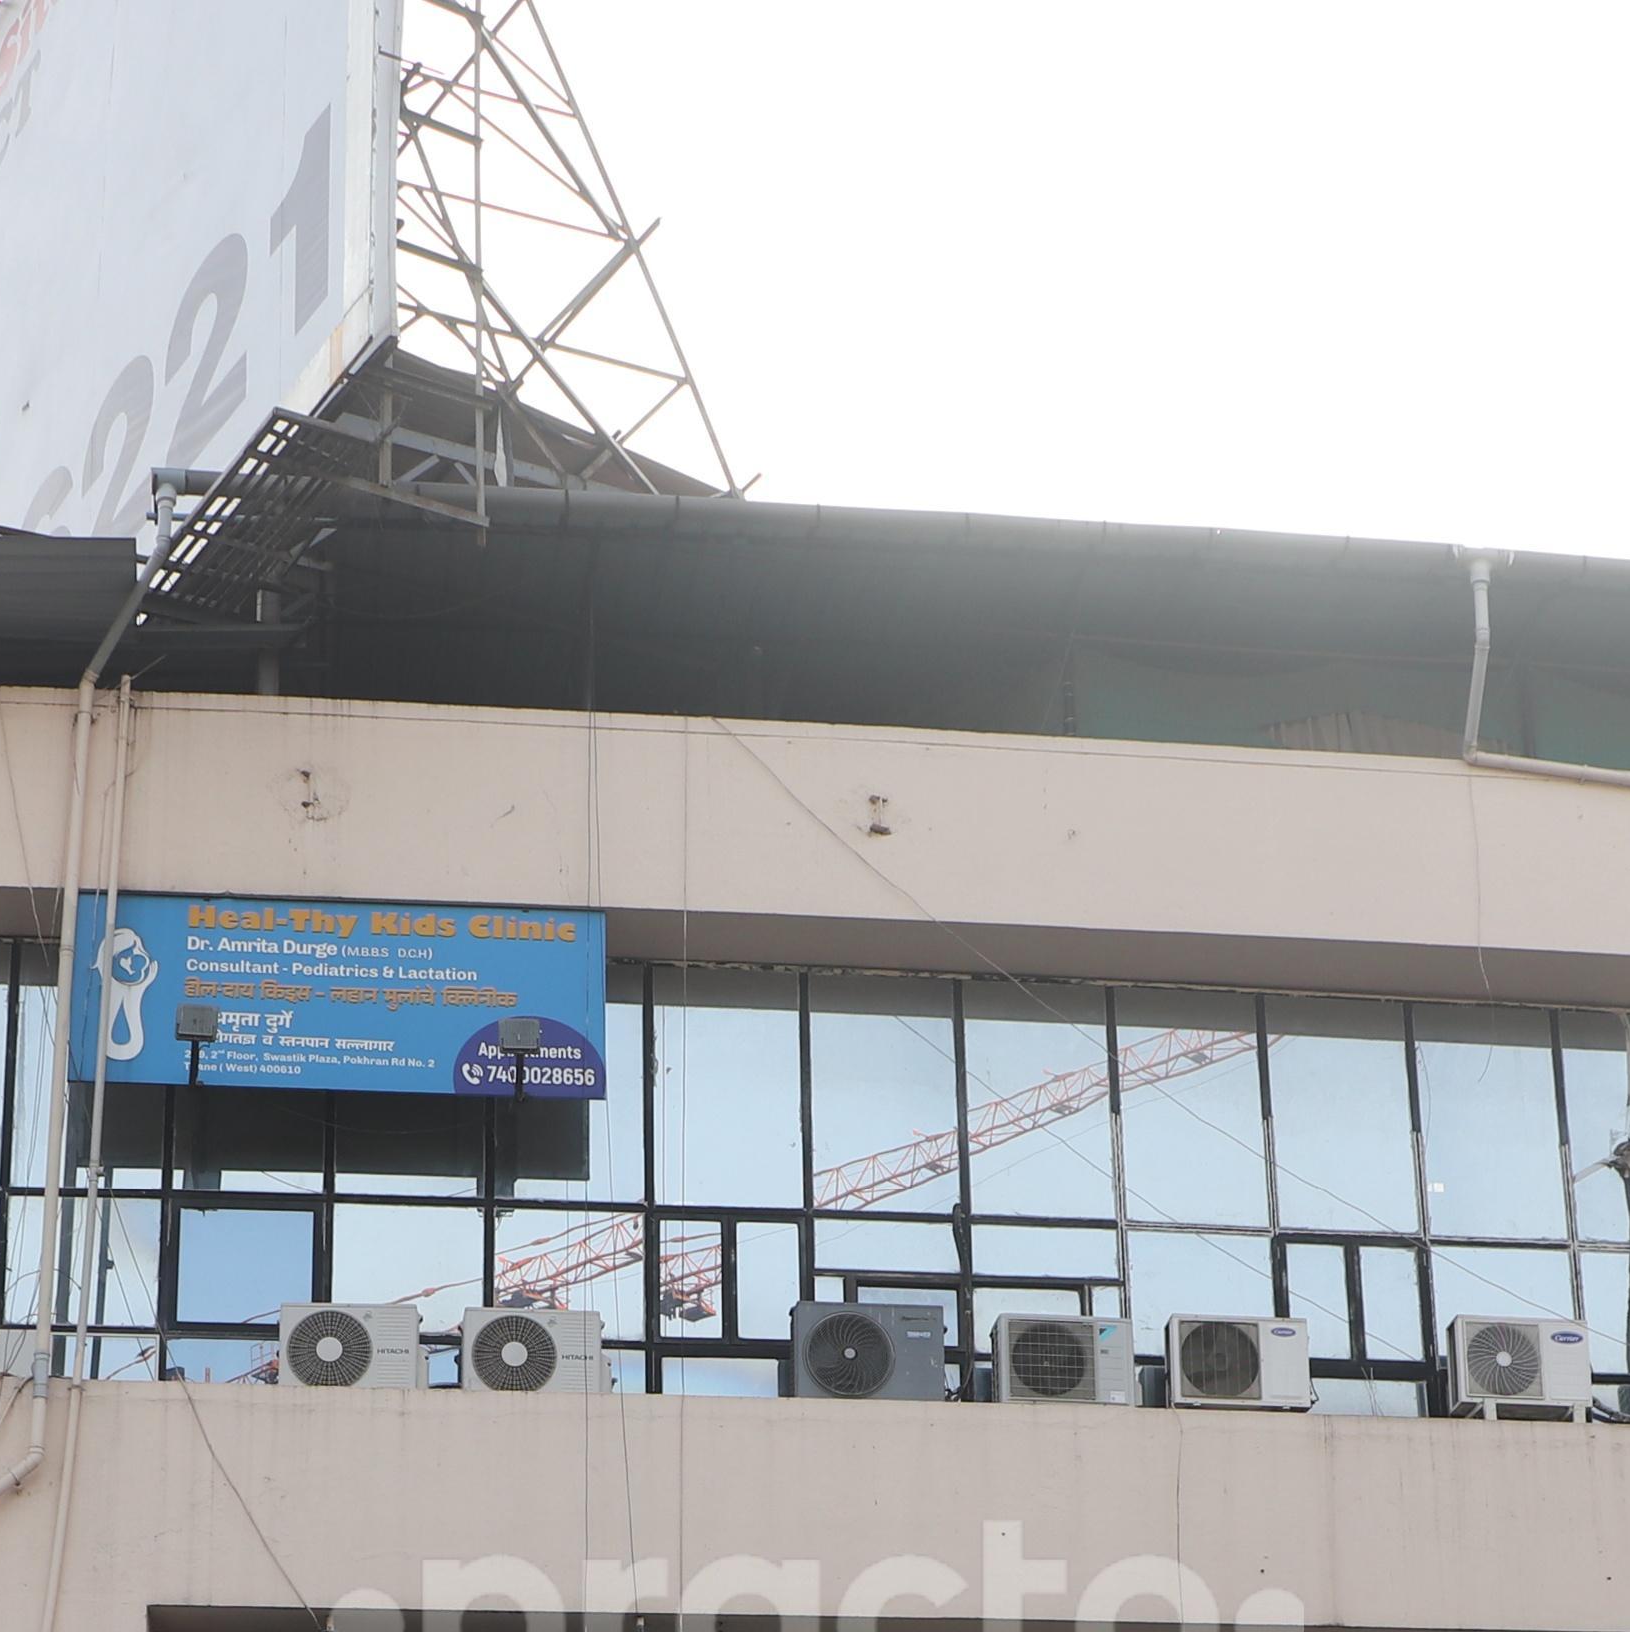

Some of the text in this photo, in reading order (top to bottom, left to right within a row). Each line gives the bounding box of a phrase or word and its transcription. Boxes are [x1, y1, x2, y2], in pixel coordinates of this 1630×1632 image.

[188, 905, 577, 942] Heal-Thy Kids Clinic
[187, 936, 337, 959] Dr. Amrita Durge
[186, 959, 477, 981] Consultant Pediatrics Lactation
[343, 1055, 389, 1067] Pokhran
